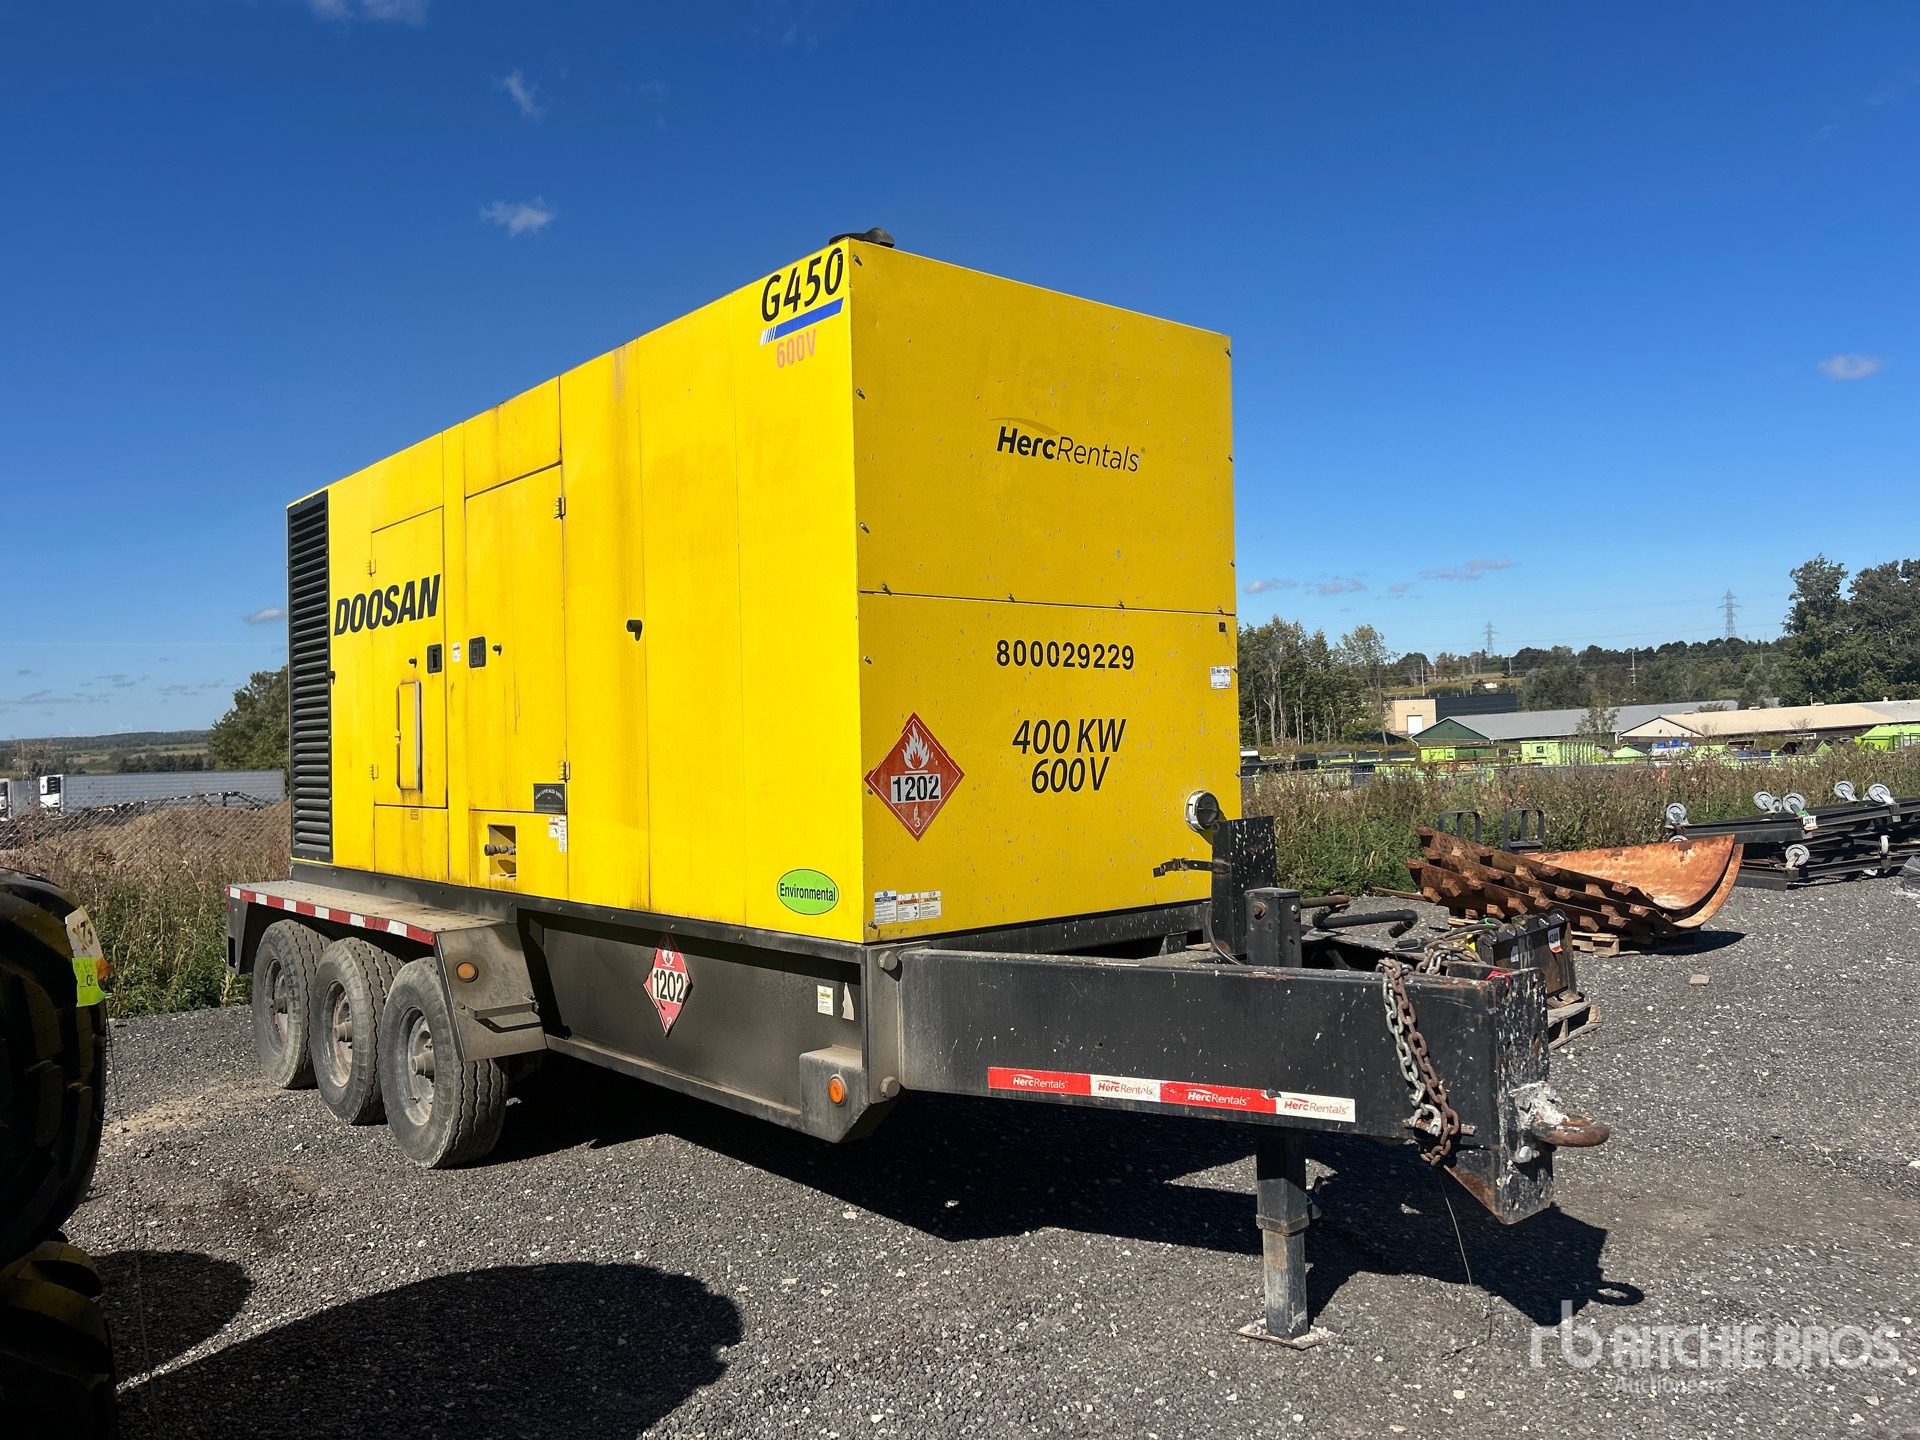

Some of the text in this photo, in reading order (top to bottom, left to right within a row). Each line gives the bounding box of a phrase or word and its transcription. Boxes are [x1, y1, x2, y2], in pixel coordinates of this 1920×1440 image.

[761, 247, 844, 322] G450
[776, 328, 817, 369] 600V
[333, 573, 441, 637] DOOSAN
[996, 639, 1135, 670] 800029229
[1011, 718, 1127, 755] 400 KW
[892, 775, 940, 802] 1202
[1031, 756, 1111, 794] 600V
[914, 817, 921, 828] 3
[779, 882, 836, 902] Environmental
[653, 969, 686, 1003] 1202
[1012, 1076, 1066, 1089] HercRentals
[1187, 1091, 1248, 1106] HercRentals
